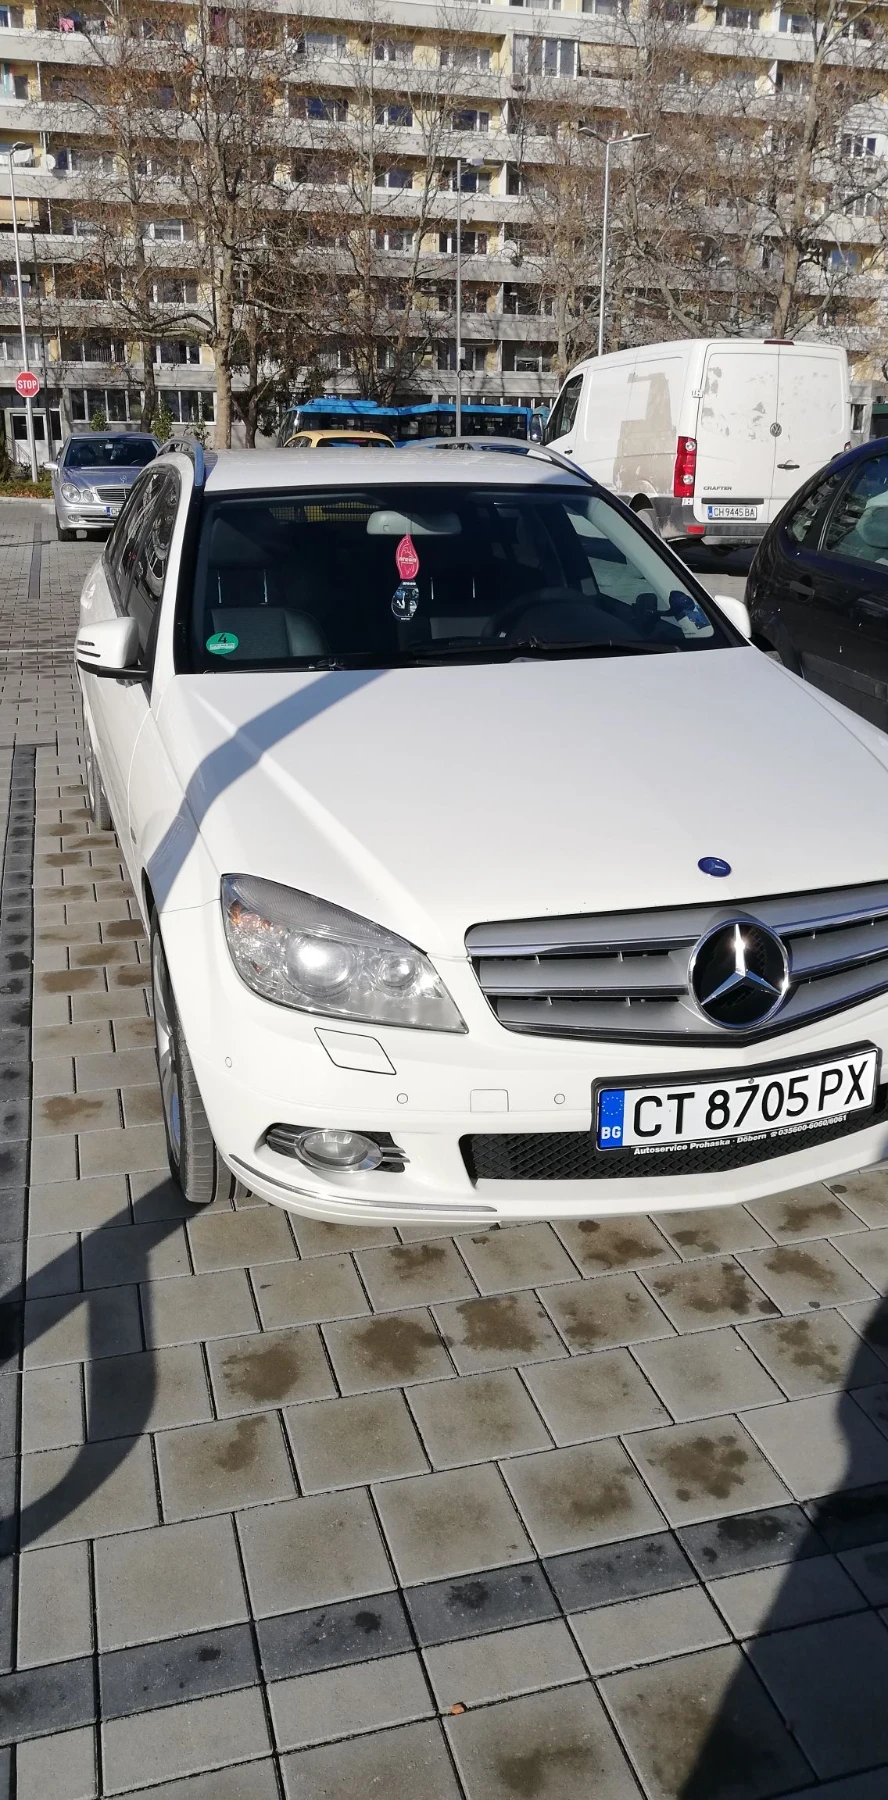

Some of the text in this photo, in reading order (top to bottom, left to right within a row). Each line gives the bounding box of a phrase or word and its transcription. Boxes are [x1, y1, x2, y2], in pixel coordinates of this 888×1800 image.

[17, 379, 37, 389] STOP
[725, 508, 743, 517] 9445
[745, 508, 755, 517] BA
[218, 633, 227, 643] 4
[633, 1060, 868, 1138] CT 8705 PX
[601, 1125, 621, 1140] BG
[634, 1144, 688, 1155] Autoservice
[689, 1138, 731, 1150] Prohaska
